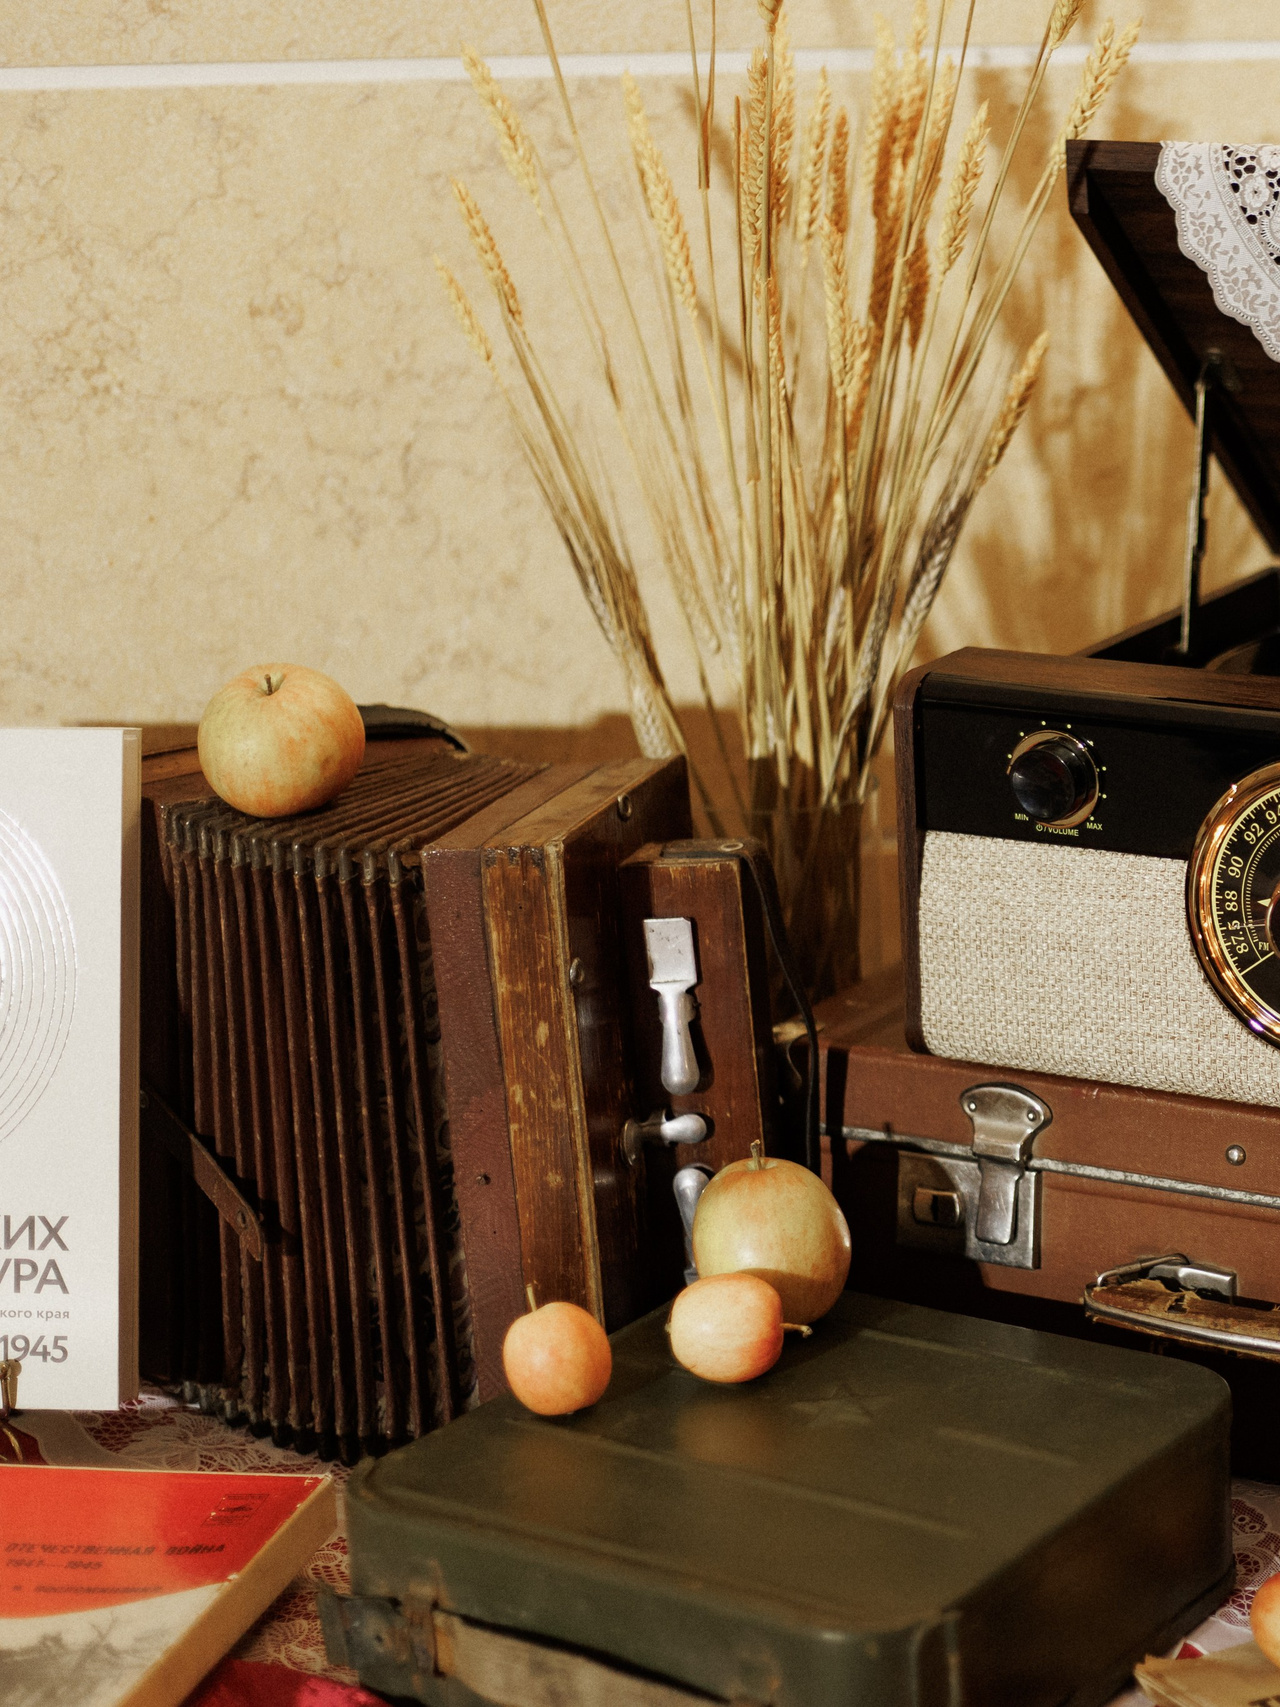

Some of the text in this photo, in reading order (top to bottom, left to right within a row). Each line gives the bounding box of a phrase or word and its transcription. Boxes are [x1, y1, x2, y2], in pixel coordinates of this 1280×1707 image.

[1014, 813, 1029, 822] MIN
[1086, 822, 1103, 831] MAX
[1243, 822, 1265, 845] 92
[1228, 856, 1244, 878] 90
[1224, 890, 1239, 912] 88
[1227, 920, 1249, 954] 87.5
[1258, 941, 1269, 951] FM
[0, 1215, 69, 1251] ИХ
[36, 1310, 70, 1321] края
[0, 1334, 68, 1363] 1945
